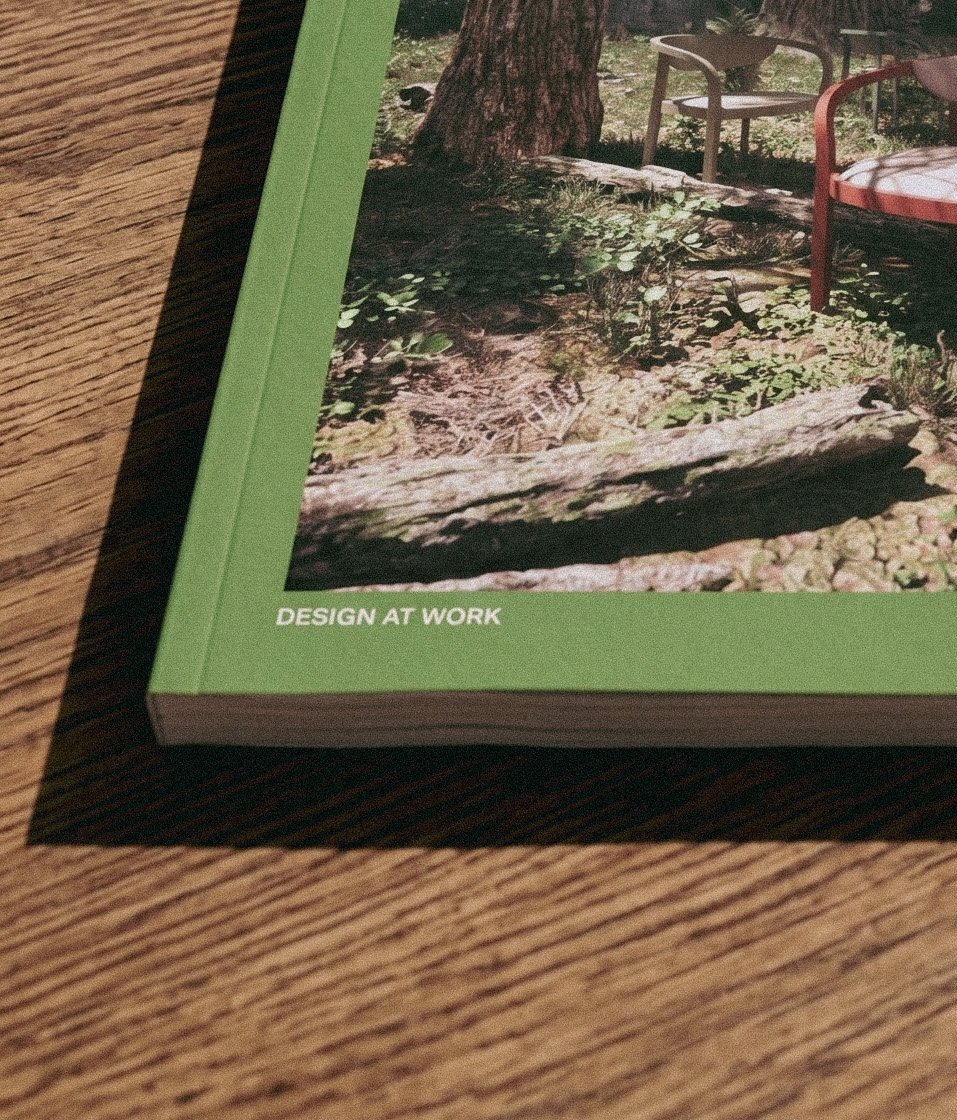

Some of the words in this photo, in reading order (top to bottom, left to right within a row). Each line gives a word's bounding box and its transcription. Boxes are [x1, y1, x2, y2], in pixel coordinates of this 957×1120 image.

[275, 607, 376, 626] DESIGN
[382, 608, 416, 625] AT
[421, 607, 502, 626] WORK
